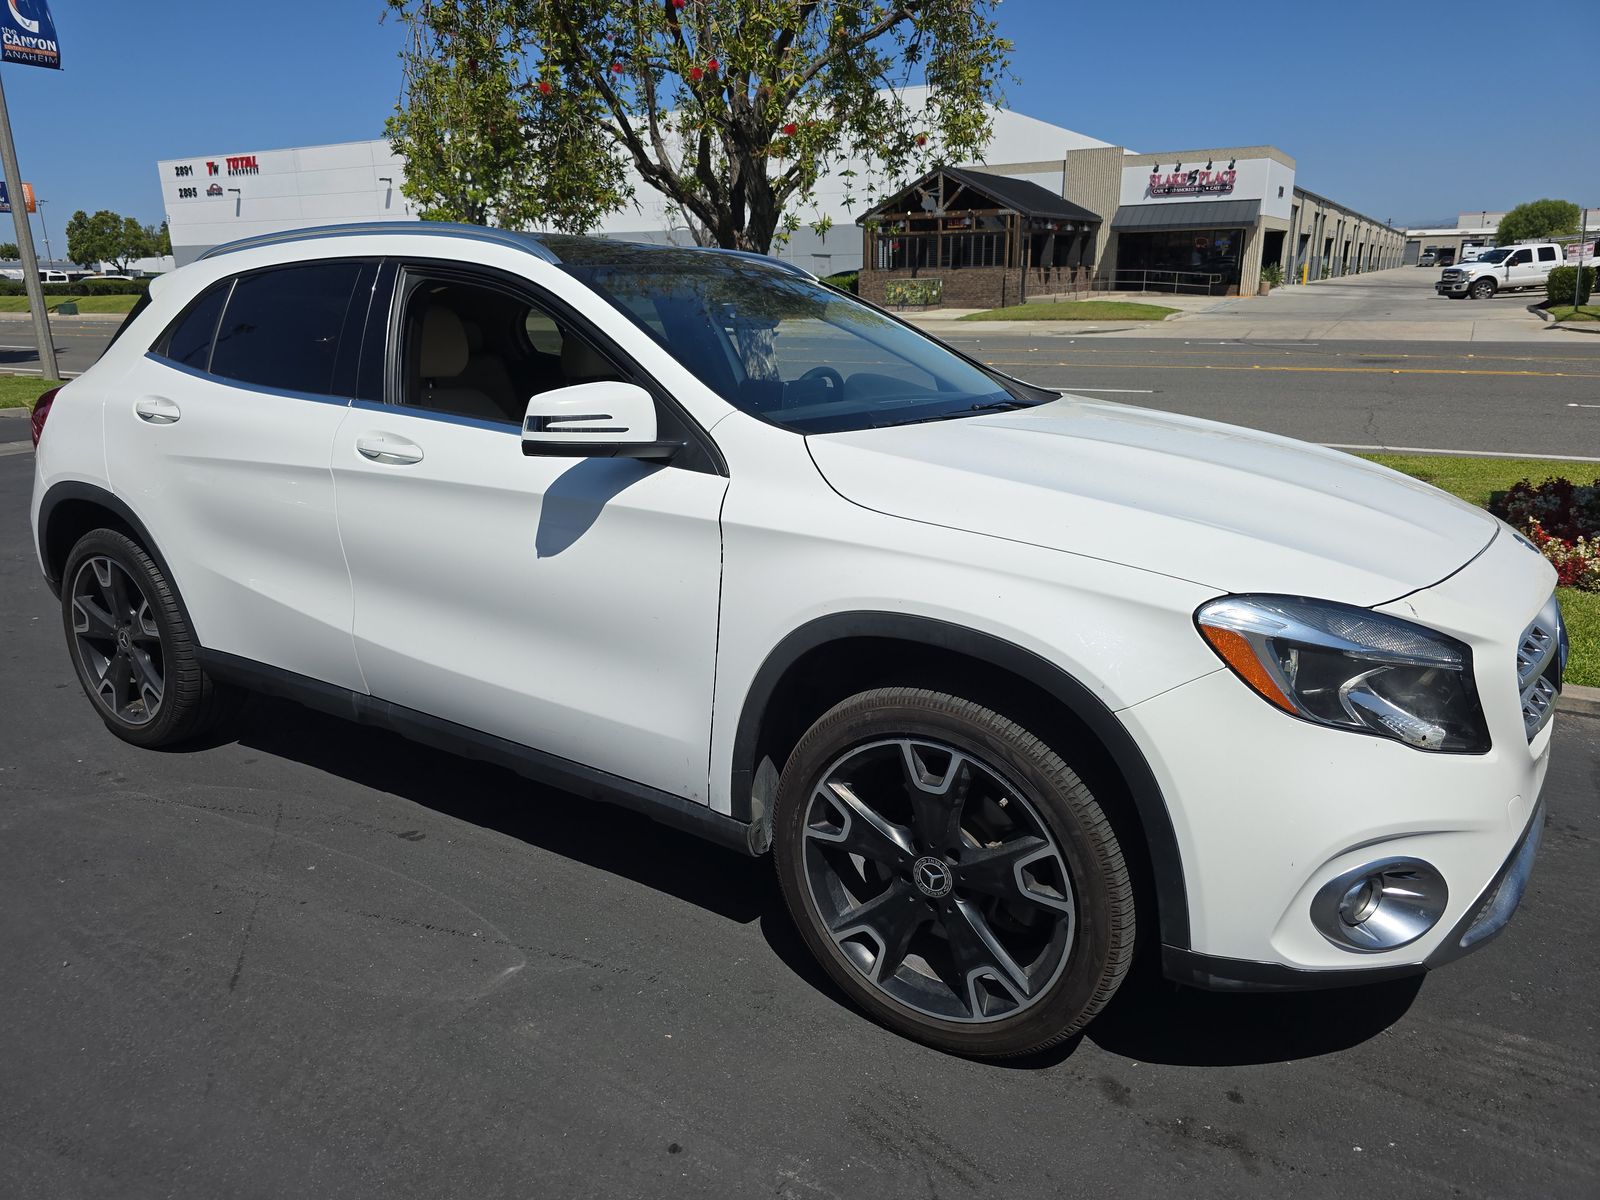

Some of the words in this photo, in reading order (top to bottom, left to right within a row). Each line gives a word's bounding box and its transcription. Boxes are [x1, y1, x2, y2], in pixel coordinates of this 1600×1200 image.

[1, 26, 17, 35] the
[2, 33, 57, 52] CANYON
[5, 50, 58, 64] ANAHEIM
[226, 156, 257, 170] TOTAL
[175, 165, 194, 177] 2891
[1199, 170, 1237, 185] PLACE
[179, 187, 198, 198] 2895
